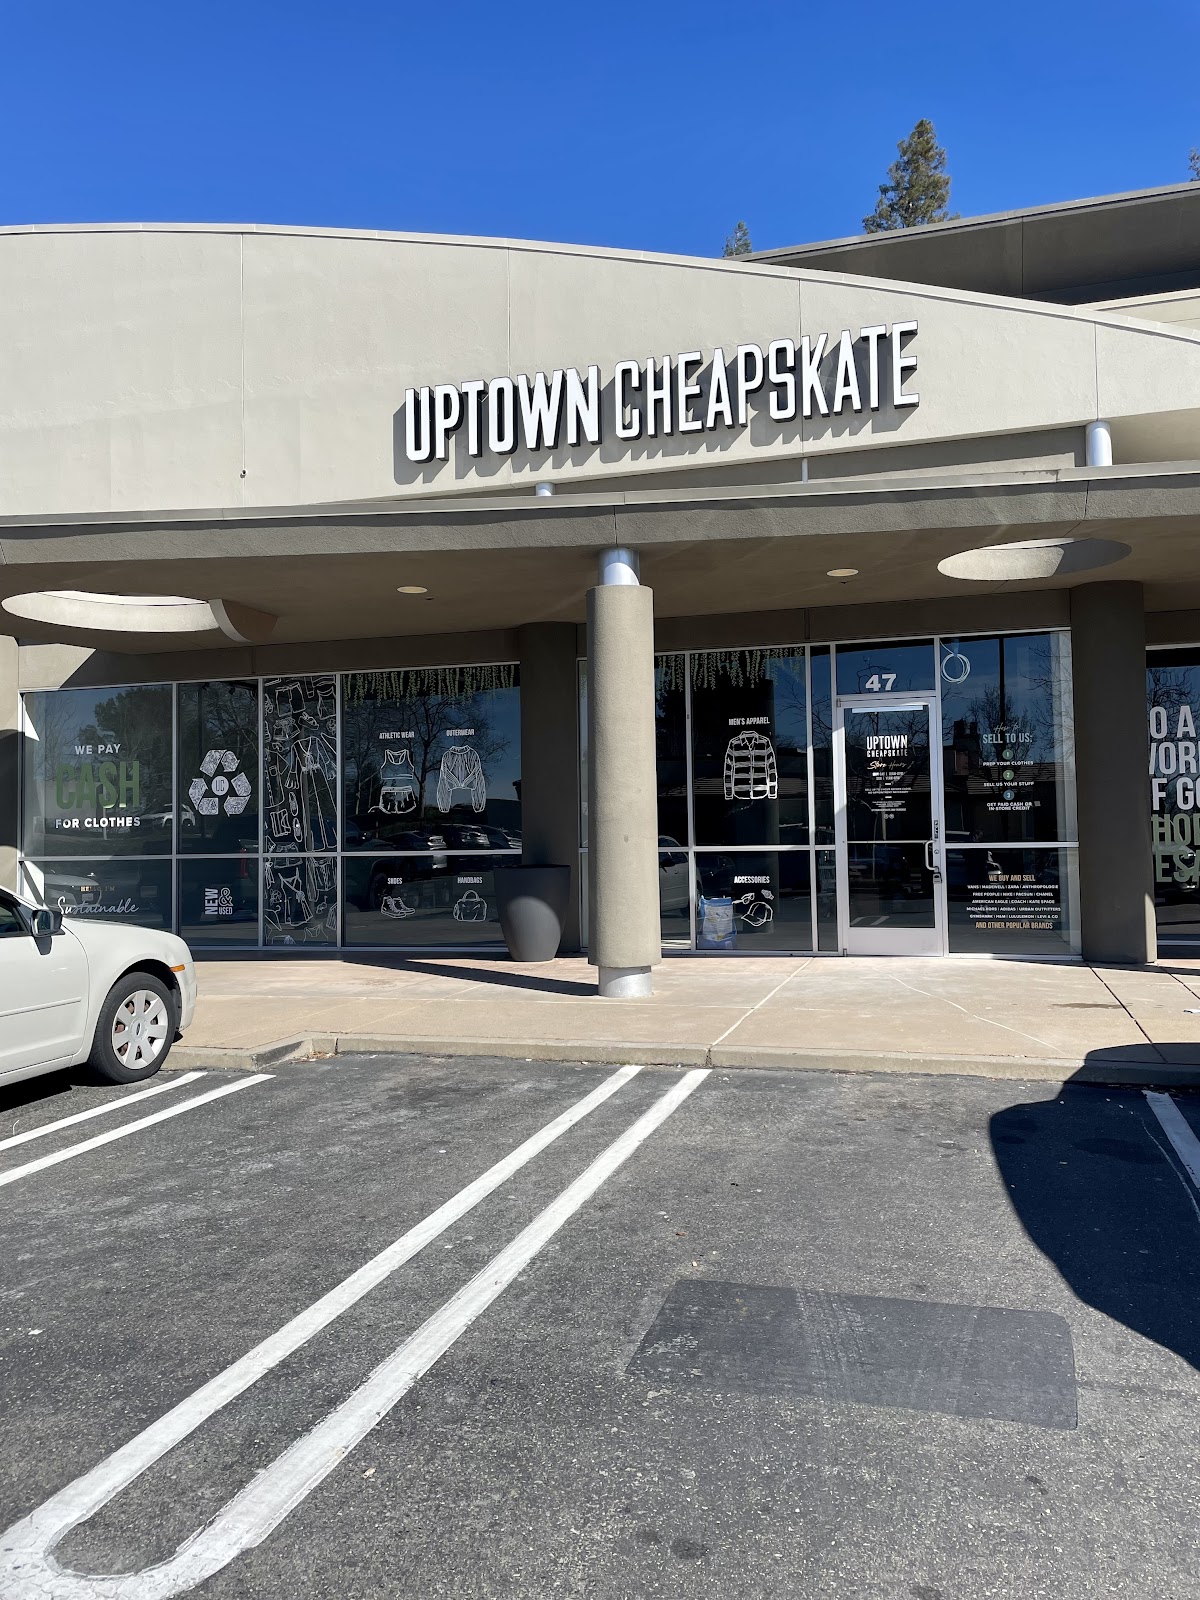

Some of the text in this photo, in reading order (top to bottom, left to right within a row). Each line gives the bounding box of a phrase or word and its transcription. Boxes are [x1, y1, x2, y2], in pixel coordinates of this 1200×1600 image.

[405, 320, 920, 464] UPTOWN CHEAPSKATE
[865, 673, 897, 692] 47
[746, 716, 770, 725] APPAREL
[446, 728, 474, 736] OUTERWEAR
[982, 732, 1032, 744] SELL TO US:
[74, 744, 122, 754] WE PAY
[866, 735, 908, 750] UPTOWN
[866, 749, 908, 758] CHEAPSKATE
[1148, 741, 1200, 774] OR
[55, 760, 140, 810] CASH
[1176, 777, 1200, 810] G
[55, 816, 141, 828] FOR CLOTHES
[57, 896, 140, 914] Sustainable
[204, 887, 234, 914] NEW & USED
